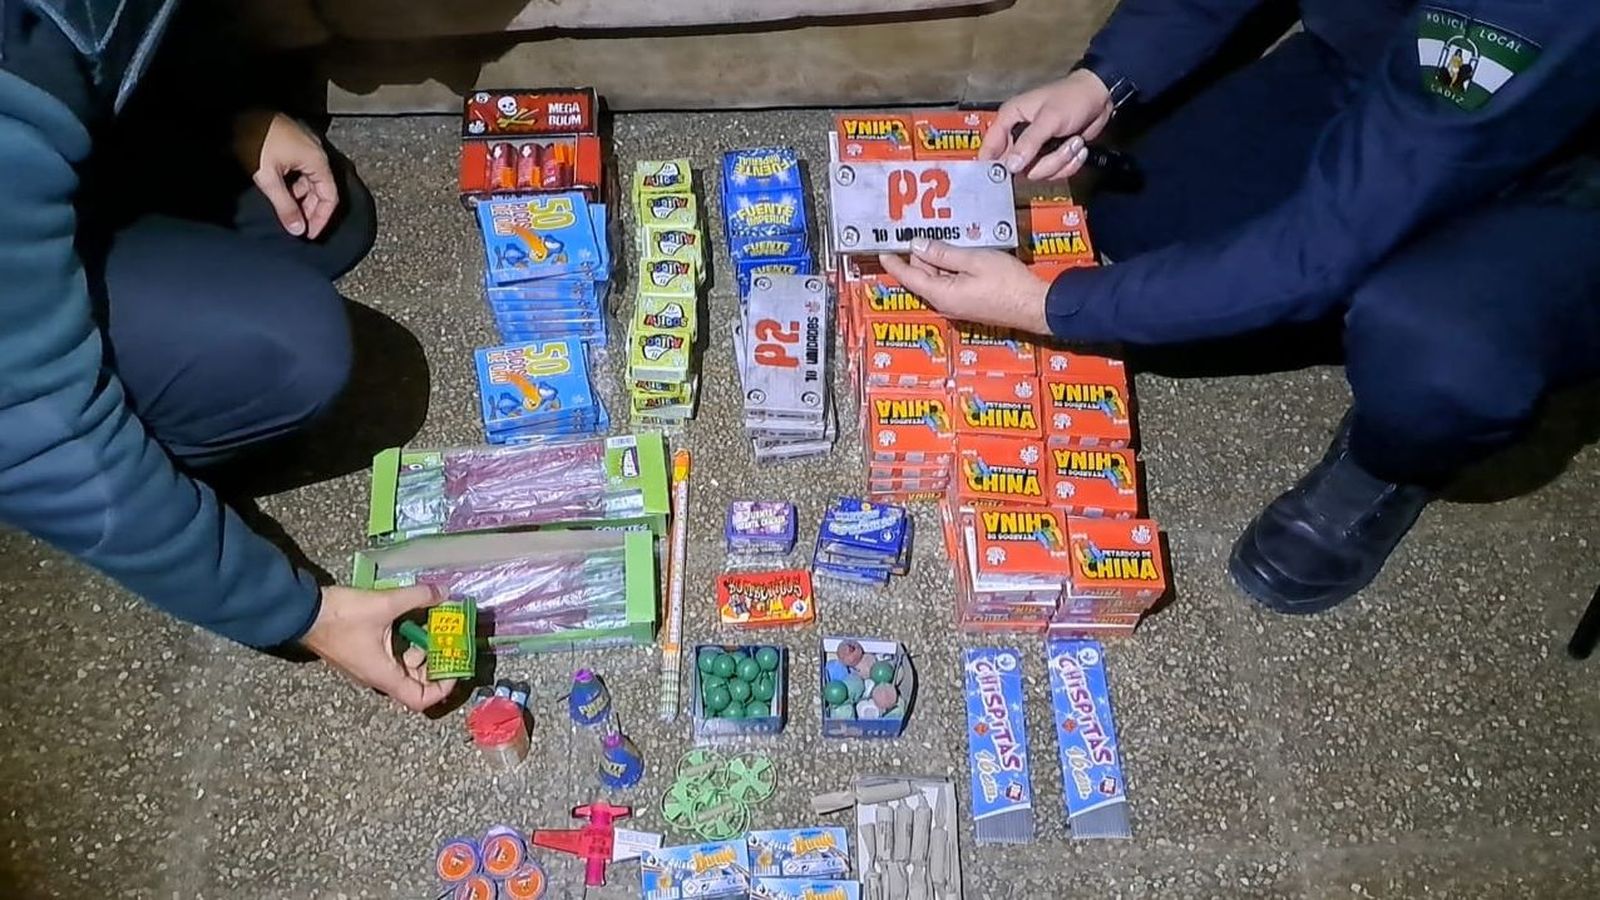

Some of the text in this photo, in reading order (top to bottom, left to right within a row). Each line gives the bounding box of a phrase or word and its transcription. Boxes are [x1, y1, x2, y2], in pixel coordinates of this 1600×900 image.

[1479, 28, 1523, 54] LOCAL
[547, 102, 580, 114] MEGA
[844, 119, 908, 139] CHINA
[920, 133, 984, 150] CHINA
[528, 198, 576, 230] 50
[736, 202, 795, 220] FUENTE
[872, 228, 888, 243] 10
[1033, 235, 1088, 256] HINA
[868, 292, 928, 311] CHIN
[873, 322, 943, 344] CHINA
[523, 341, 571, 377] 50
[805, 370, 818, 383] 10
[1049, 383, 1122, 405] CHINA
[875, 399, 947, 421] CHINA
[964, 406, 1038, 430] CHINA
[1054, 450, 1127, 474] CHINA
[967, 472, 1042, 496] CHINA
[982, 511, 1060, 536] CHINA
[1101, 549, 1140, 558] PETARDOS
[1080, 556, 1158, 580] CHINA
[433, 624, 457, 633] POT
[439, 615, 460, 625] TEA
[975, 660, 1022, 772] CHISPITAS
[1058, 655, 1114, 767] CHISPITAS
